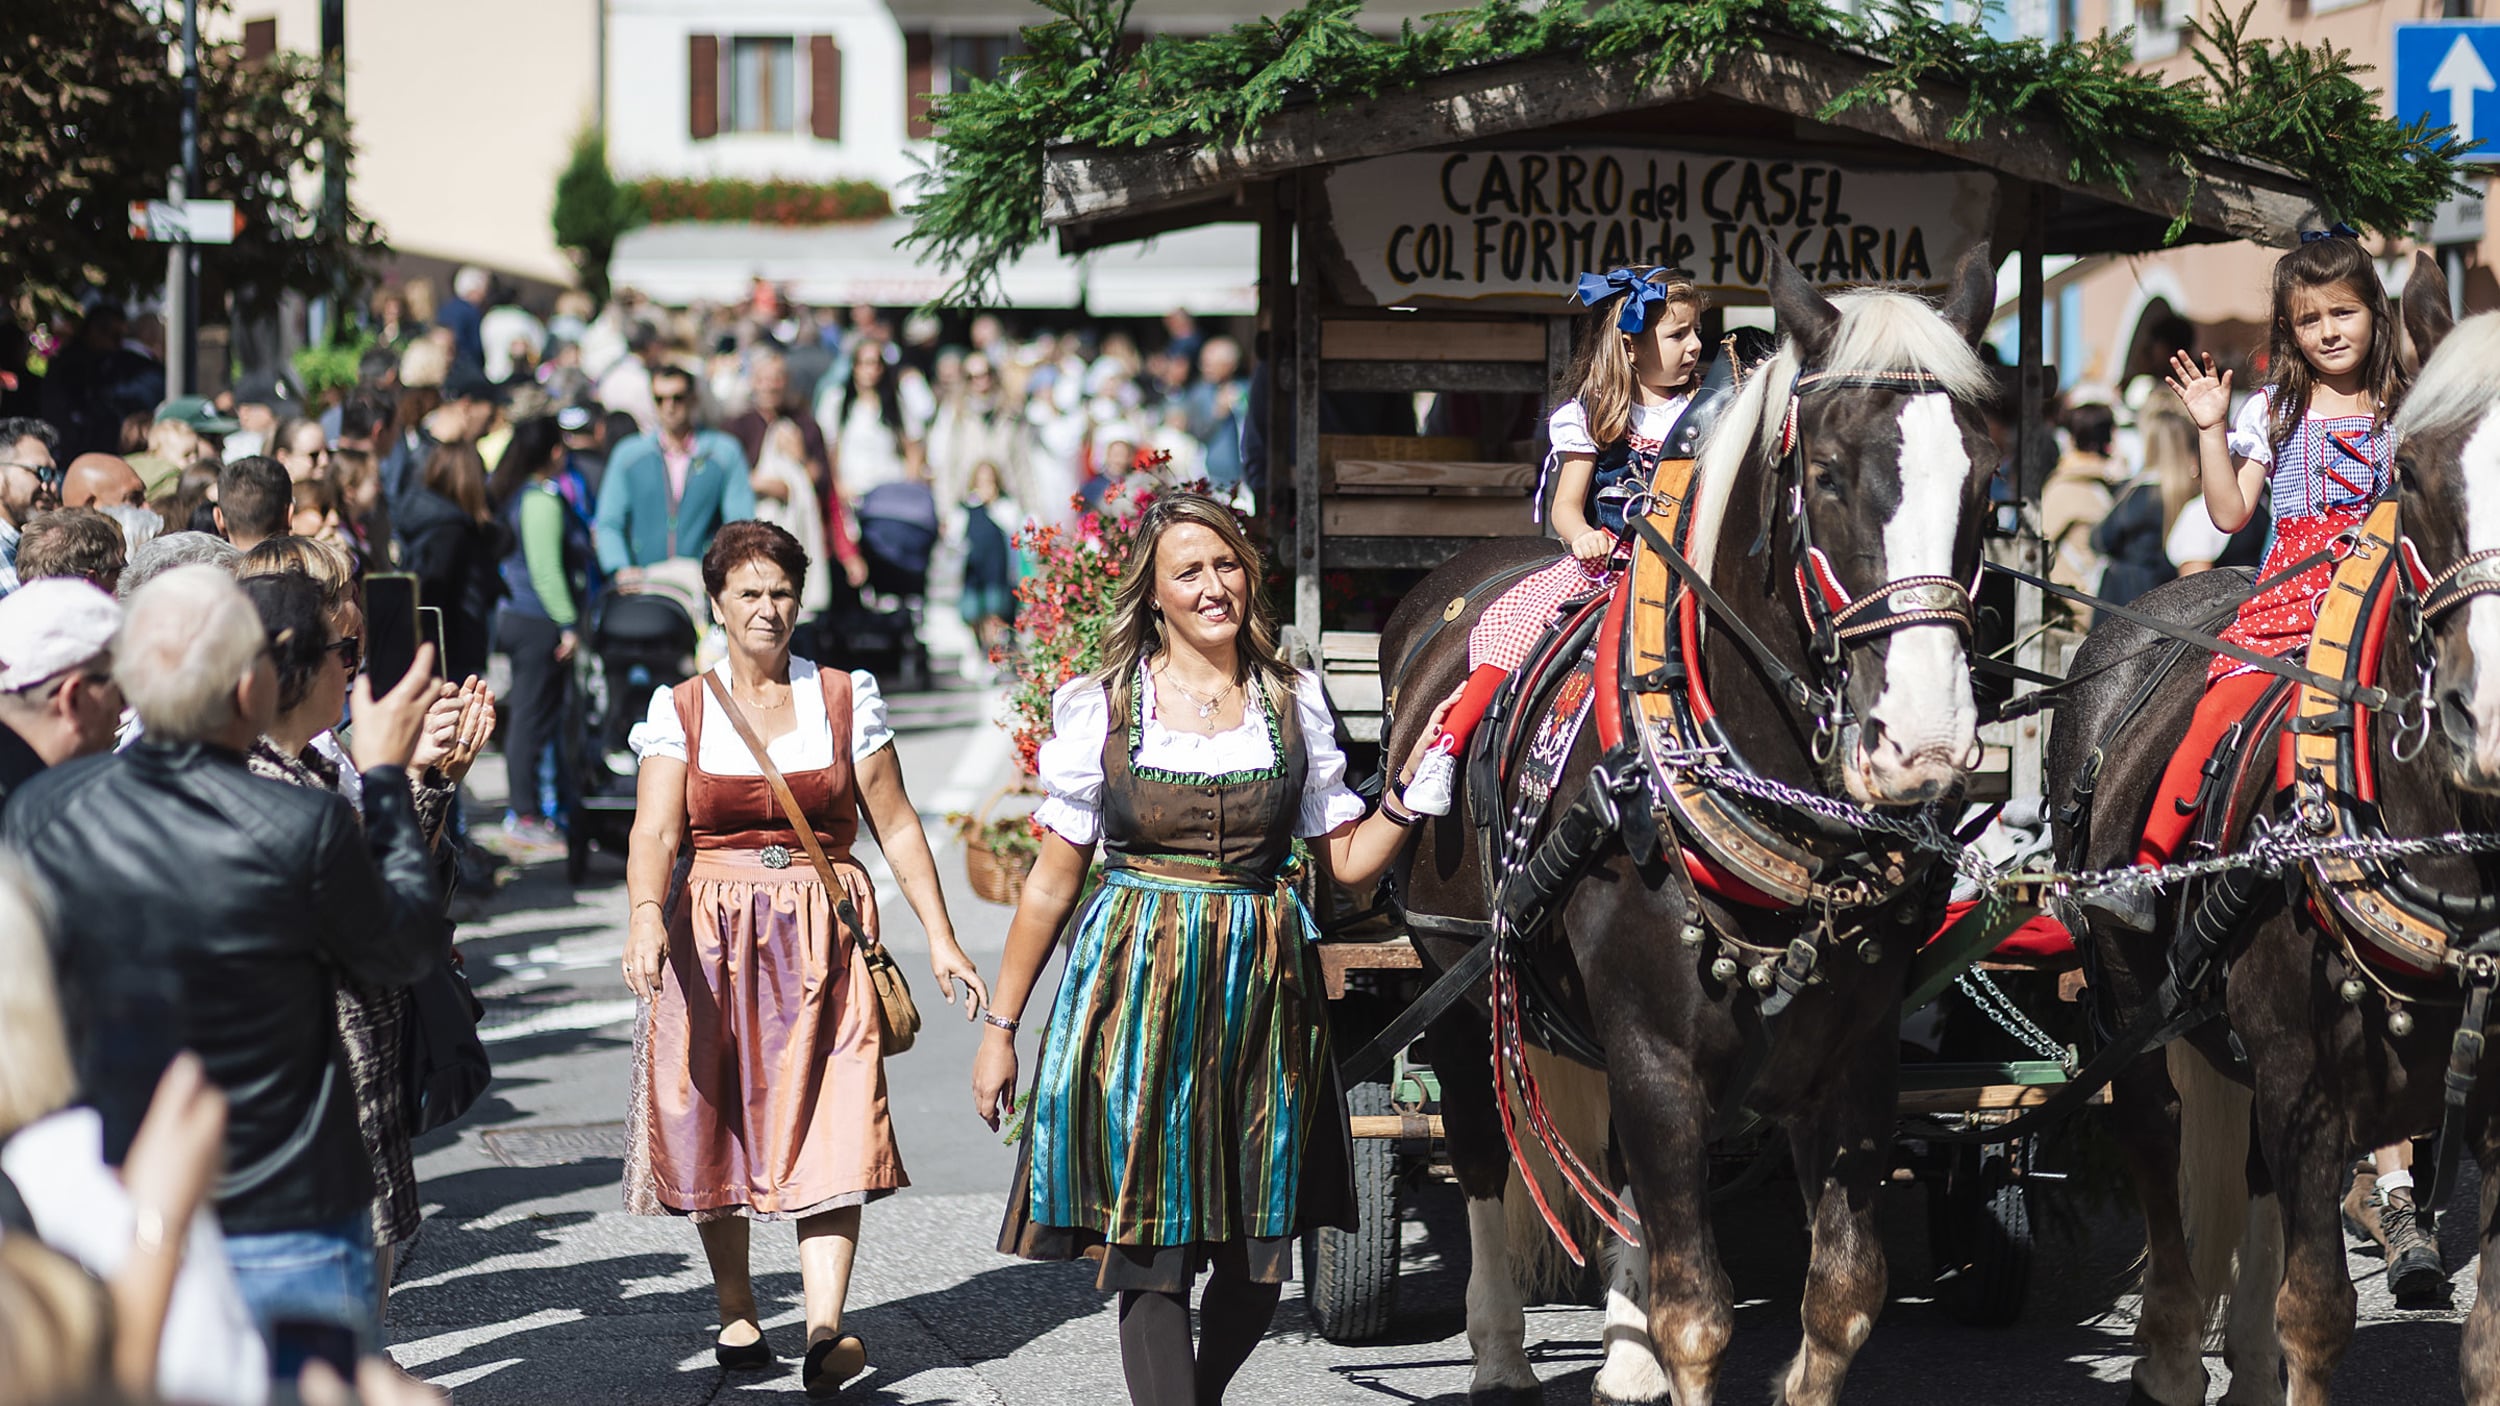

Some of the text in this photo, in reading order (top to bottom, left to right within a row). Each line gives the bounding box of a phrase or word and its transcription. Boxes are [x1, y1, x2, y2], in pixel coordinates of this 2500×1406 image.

[1441, 153, 1850, 228] CARRO del CASEL
[1387, 222, 1464, 284] COL
[1710, 223, 1932, 286] FOGARIA
